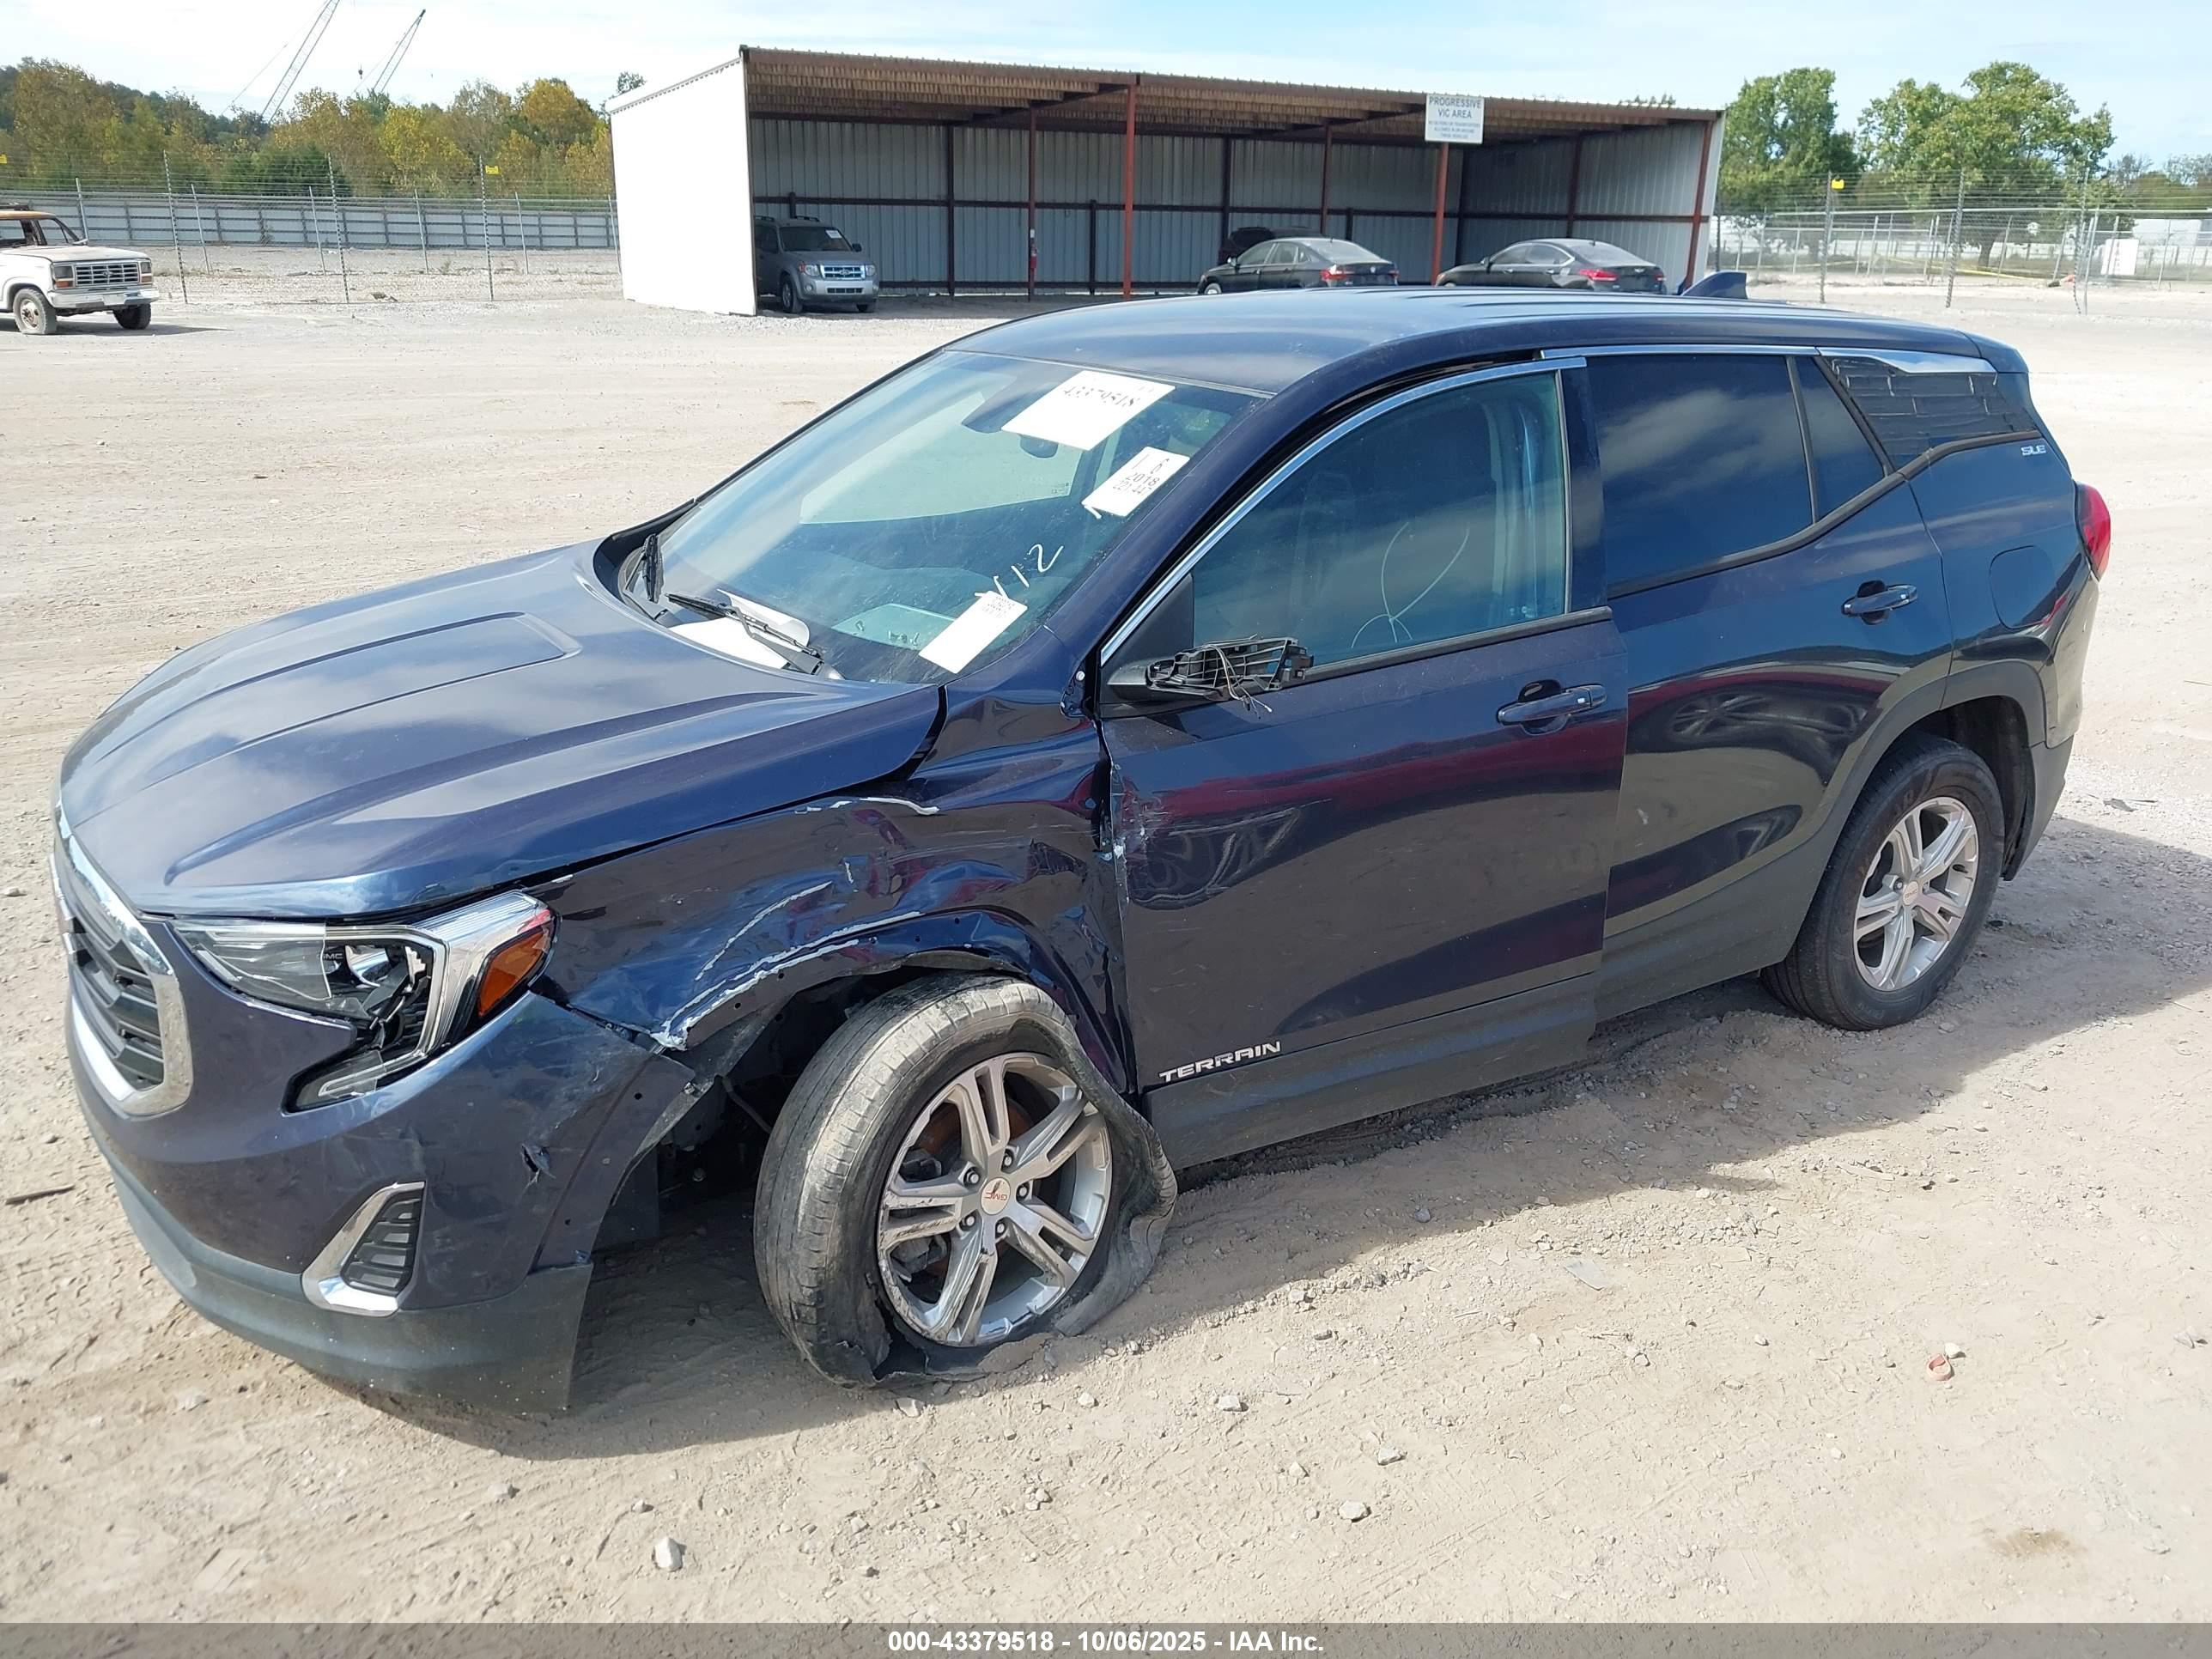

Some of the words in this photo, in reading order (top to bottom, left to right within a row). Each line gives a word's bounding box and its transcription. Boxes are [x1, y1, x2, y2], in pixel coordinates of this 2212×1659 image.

[1429, 96, 1482, 109] PROGRESSIVE
[1438, 108, 1450, 118] VIC
[1452, 109, 1472, 118] AREA
[1125, 471, 1161, 487] 2018
[1158, 1041, 1282, 1083] TERRAIN
[983, 1191, 1008, 1201] GMC
